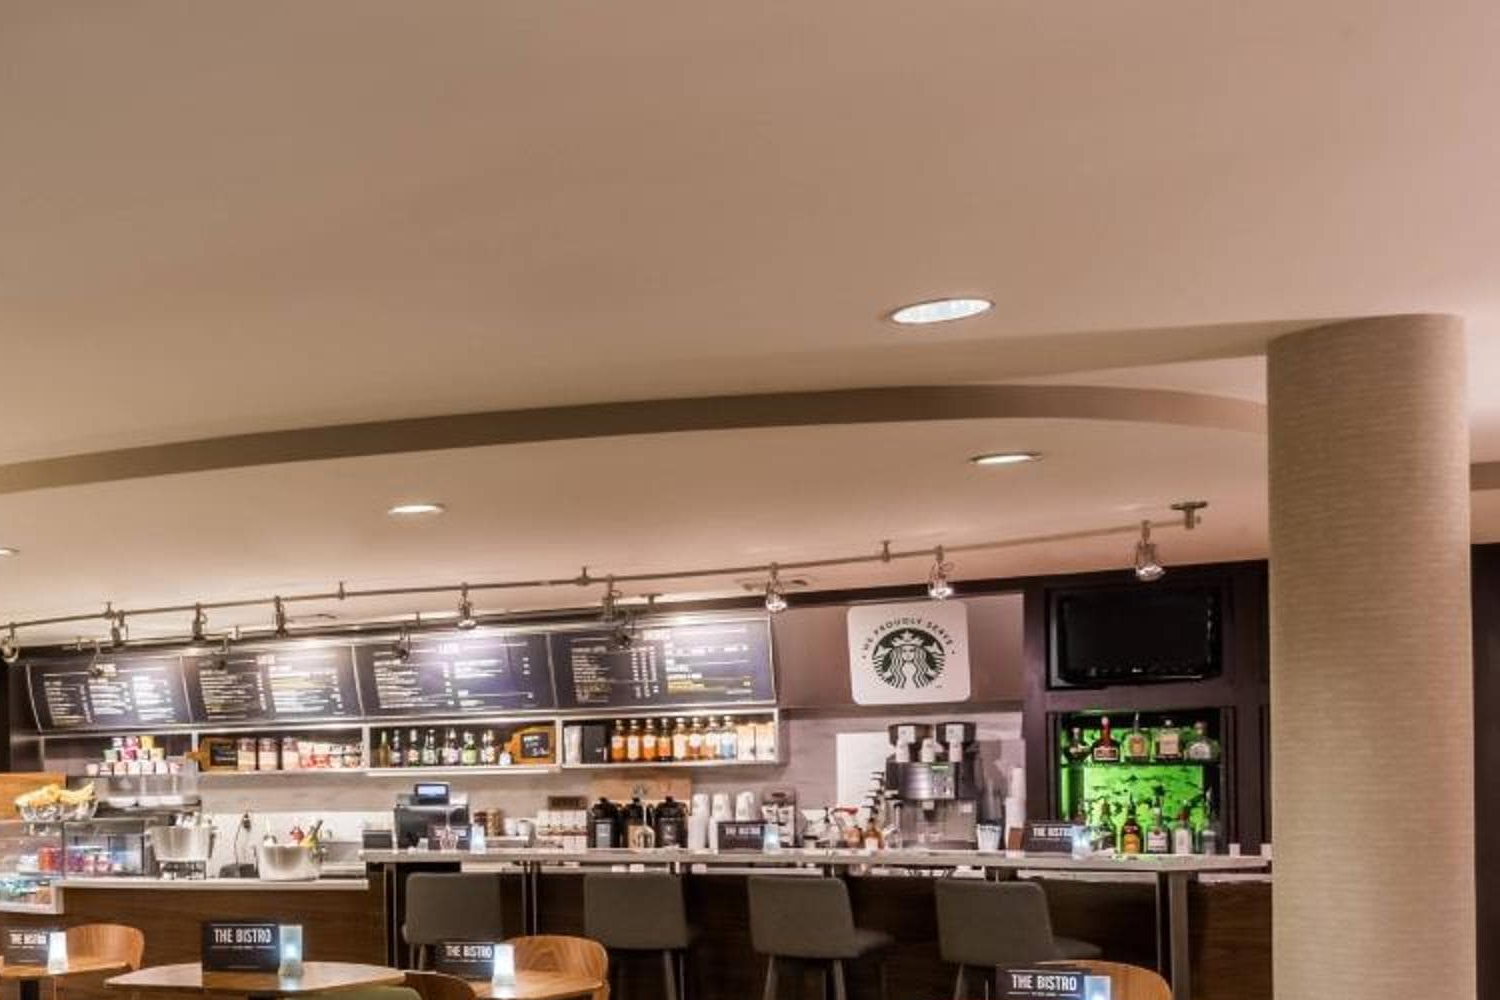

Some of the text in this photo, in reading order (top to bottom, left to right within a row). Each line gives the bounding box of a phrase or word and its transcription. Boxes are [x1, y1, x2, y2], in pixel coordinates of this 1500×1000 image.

[873, 617, 922, 636] PROUDLY
[926, 621, 953, 645] SERVE
[214, 928, 272, 943] THE BISTRO
[1011, 974, 1078, 991] THE BISTRO
